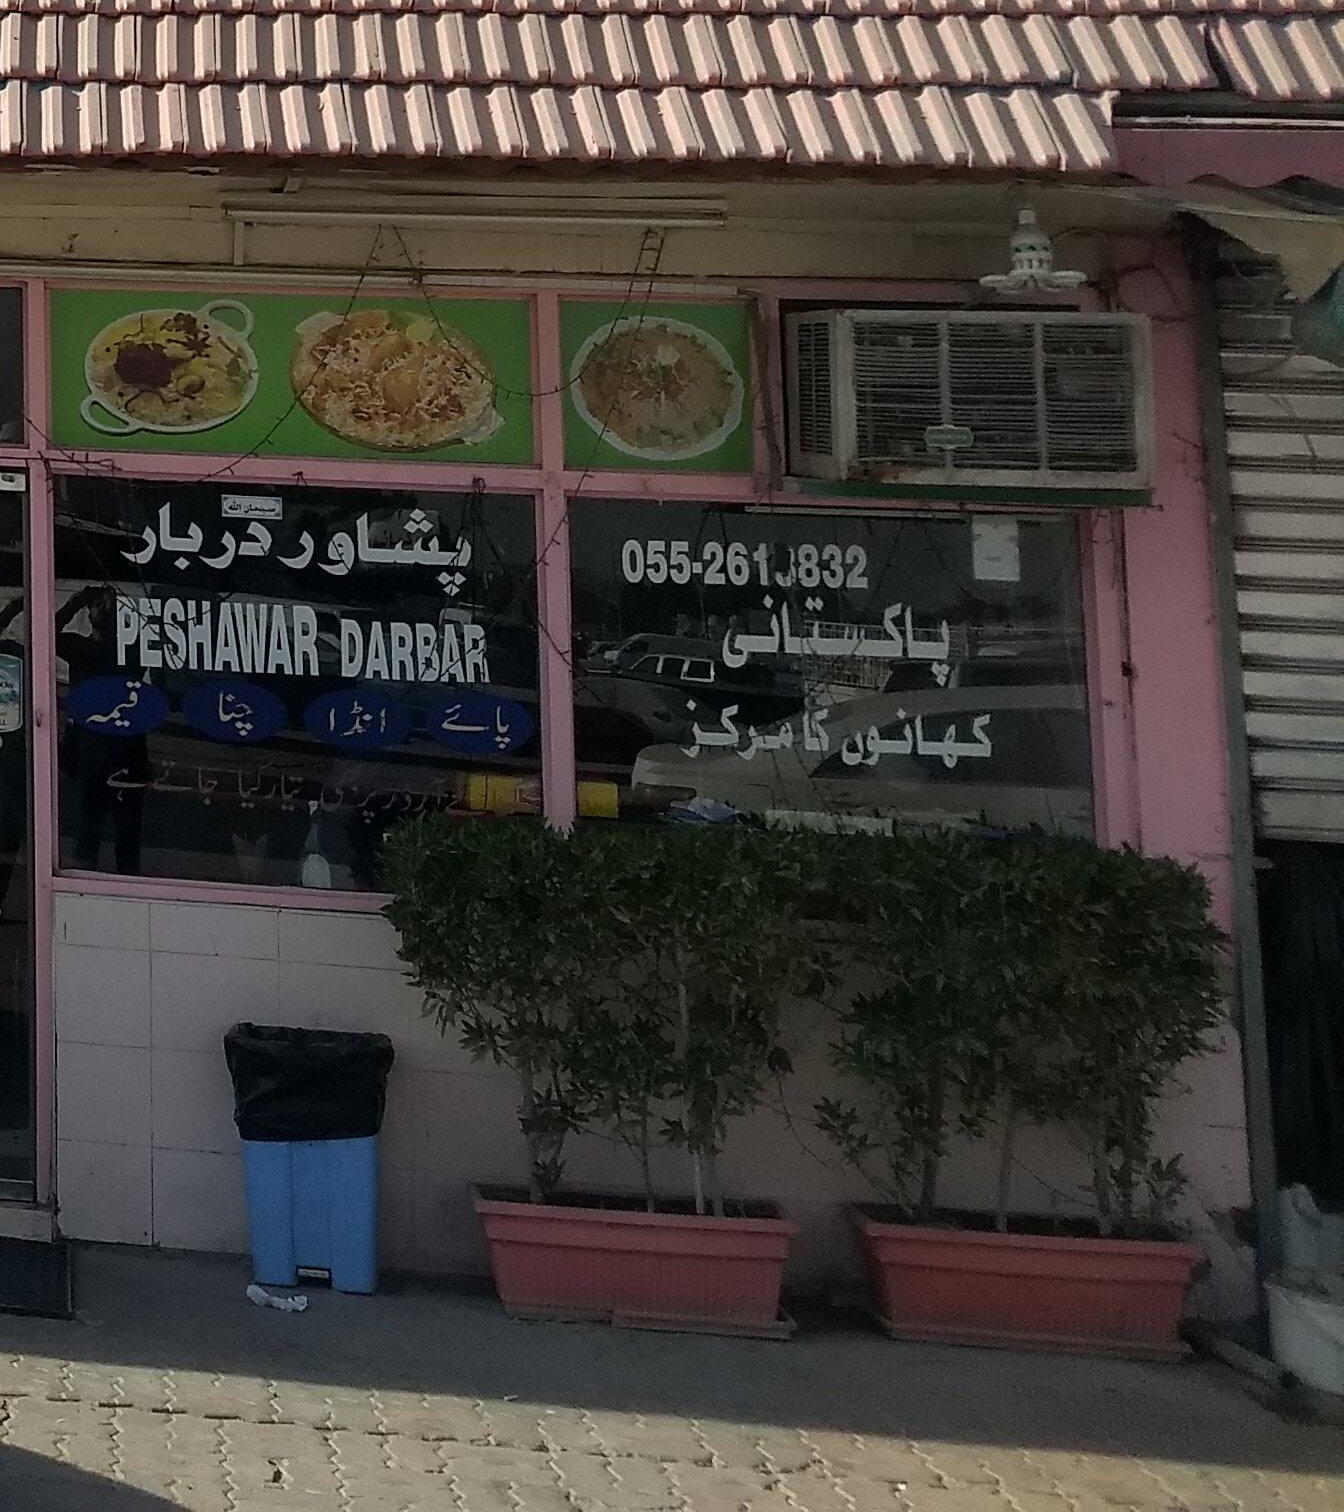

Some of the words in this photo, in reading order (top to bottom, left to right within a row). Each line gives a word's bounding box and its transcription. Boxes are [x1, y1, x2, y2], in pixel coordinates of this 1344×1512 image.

[120, 502, 272, 571] دربار
[277, 508, 472, 597] پشاور
[116, 595, 320, 677] PESHAWAR
[340, 618, 491, 683] DARBAR
